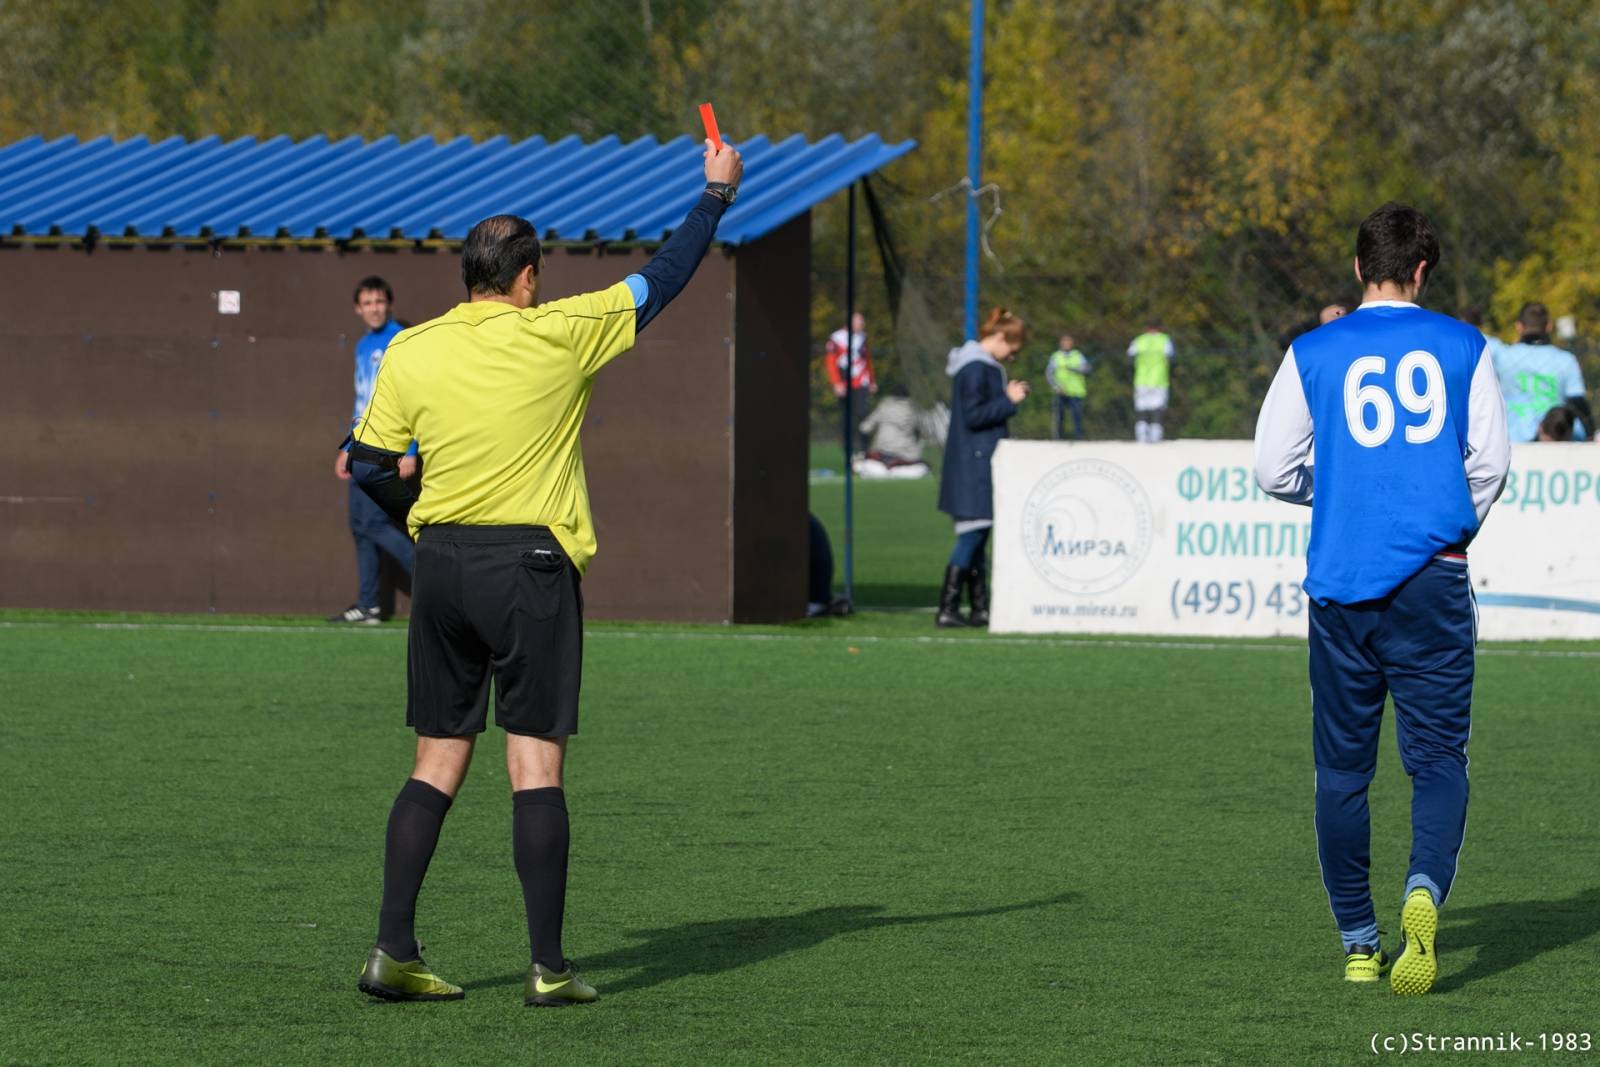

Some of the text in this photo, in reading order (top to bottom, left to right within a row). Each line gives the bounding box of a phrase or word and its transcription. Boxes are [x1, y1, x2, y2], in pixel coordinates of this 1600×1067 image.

[1343, 350, 1447, 448] 69
[1502, 469, 1600, 512] ЗДОР
[1041, 524, 1128, 556] МИРЭА
[1171, 579, 1256, 621] (495)
